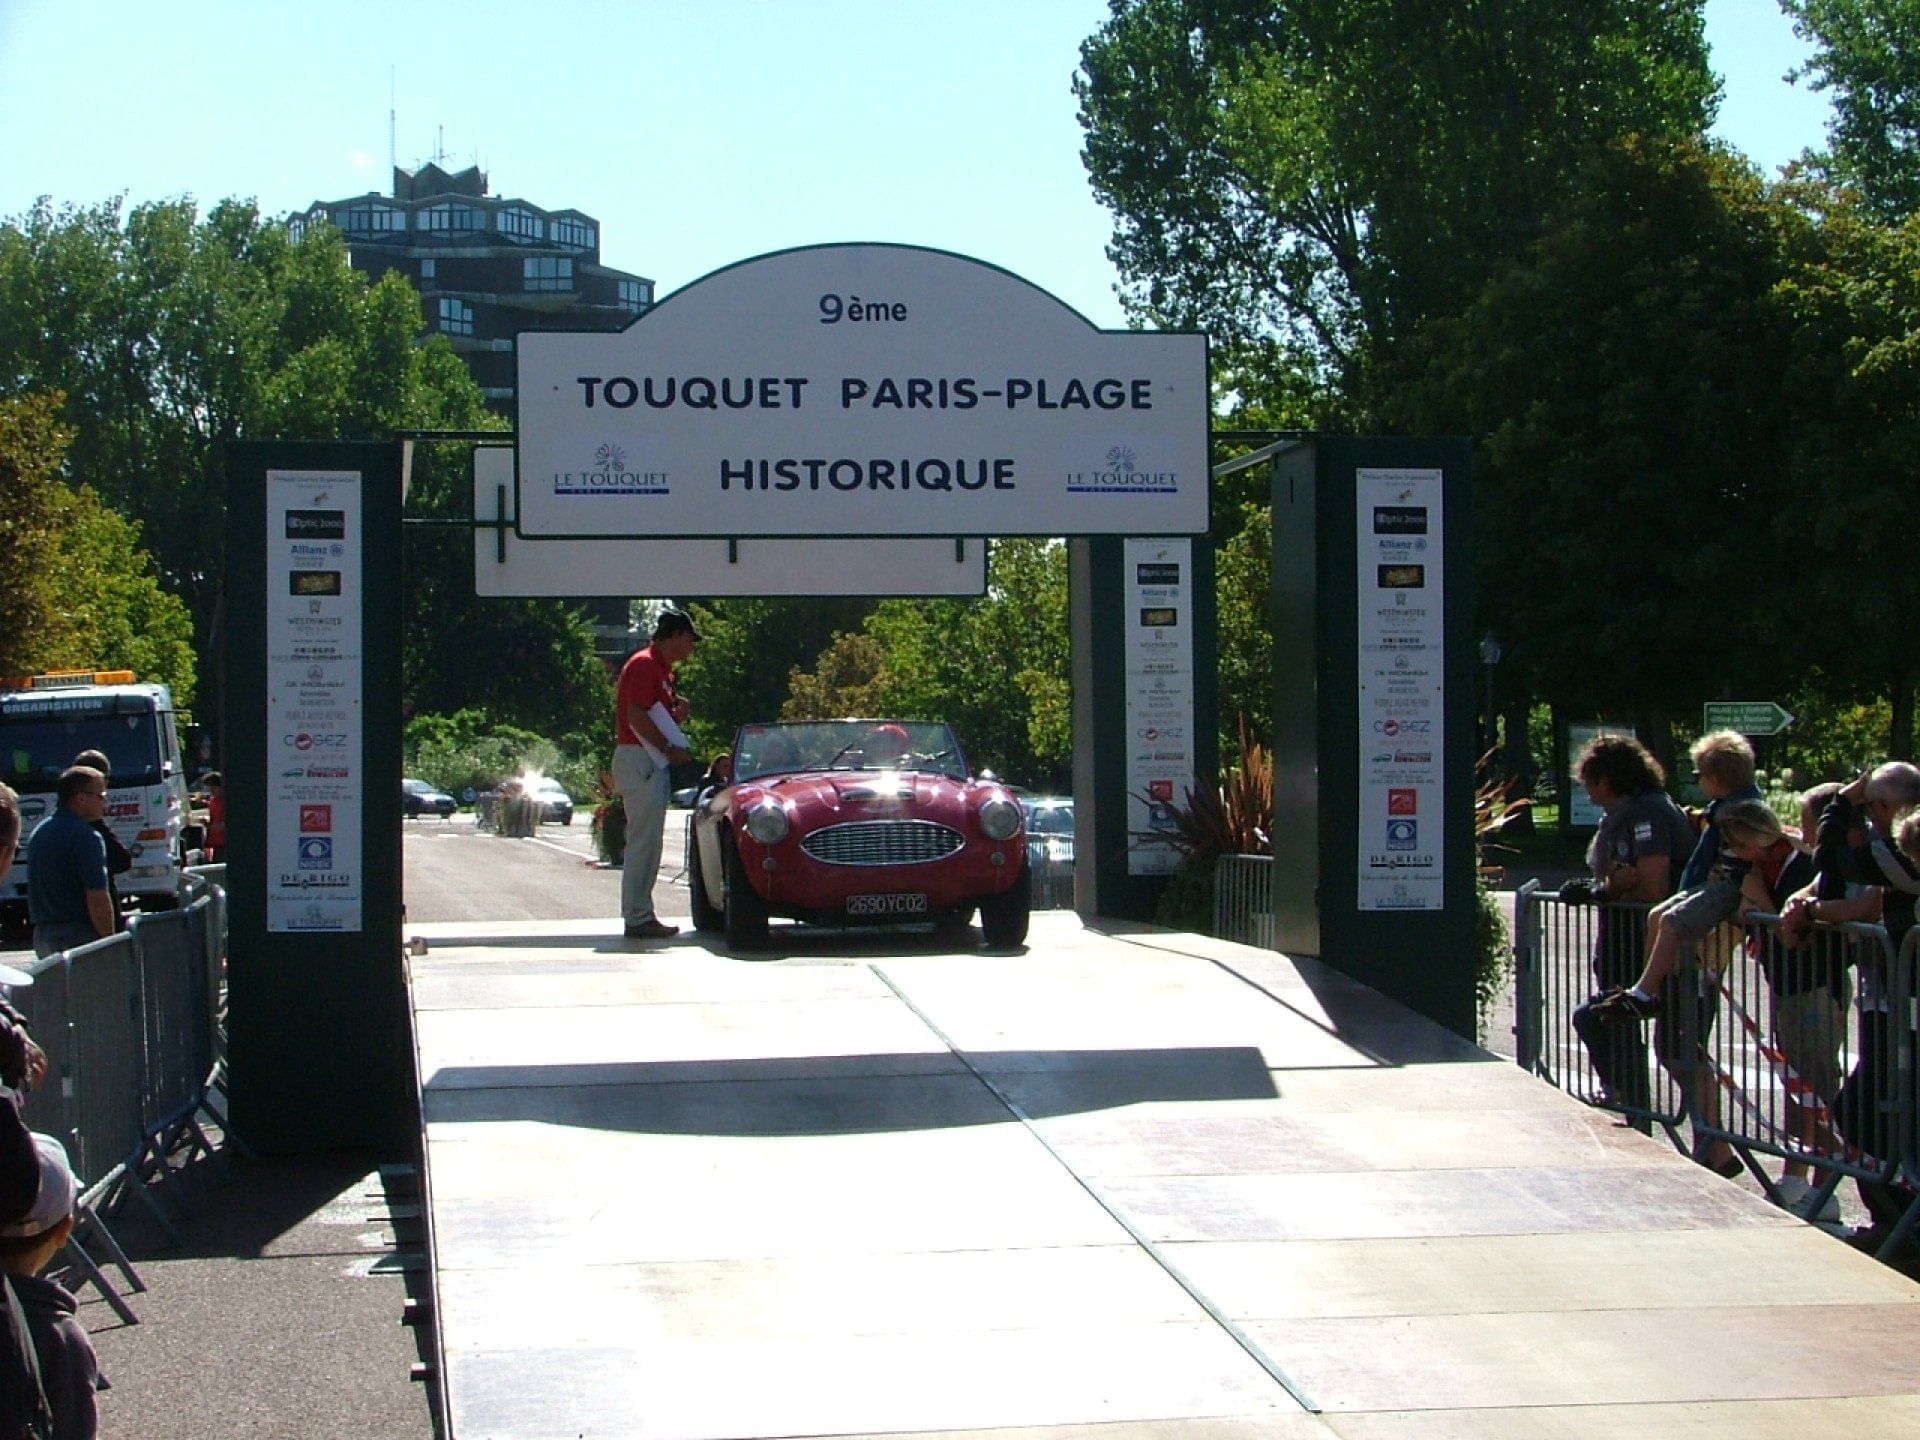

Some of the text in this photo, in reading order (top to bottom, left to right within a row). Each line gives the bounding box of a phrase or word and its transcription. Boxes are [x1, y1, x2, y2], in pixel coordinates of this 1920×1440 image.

[819, 293, 907, 324] 9ème
[577, 377, 1153, 410] TOUQUET PARIS-PLAGE
[554, 472, 670, 486] LE TOUQUET
[720, 458, 1015, 492] HISTORIQUE
[1067, 472, 1177, 485] LE TOUQUET
[290, 545, 328, 555] Allianz
[2, 701, 103, 713] ORGANISATION
[283, 733, 348, 750] COGEZ
